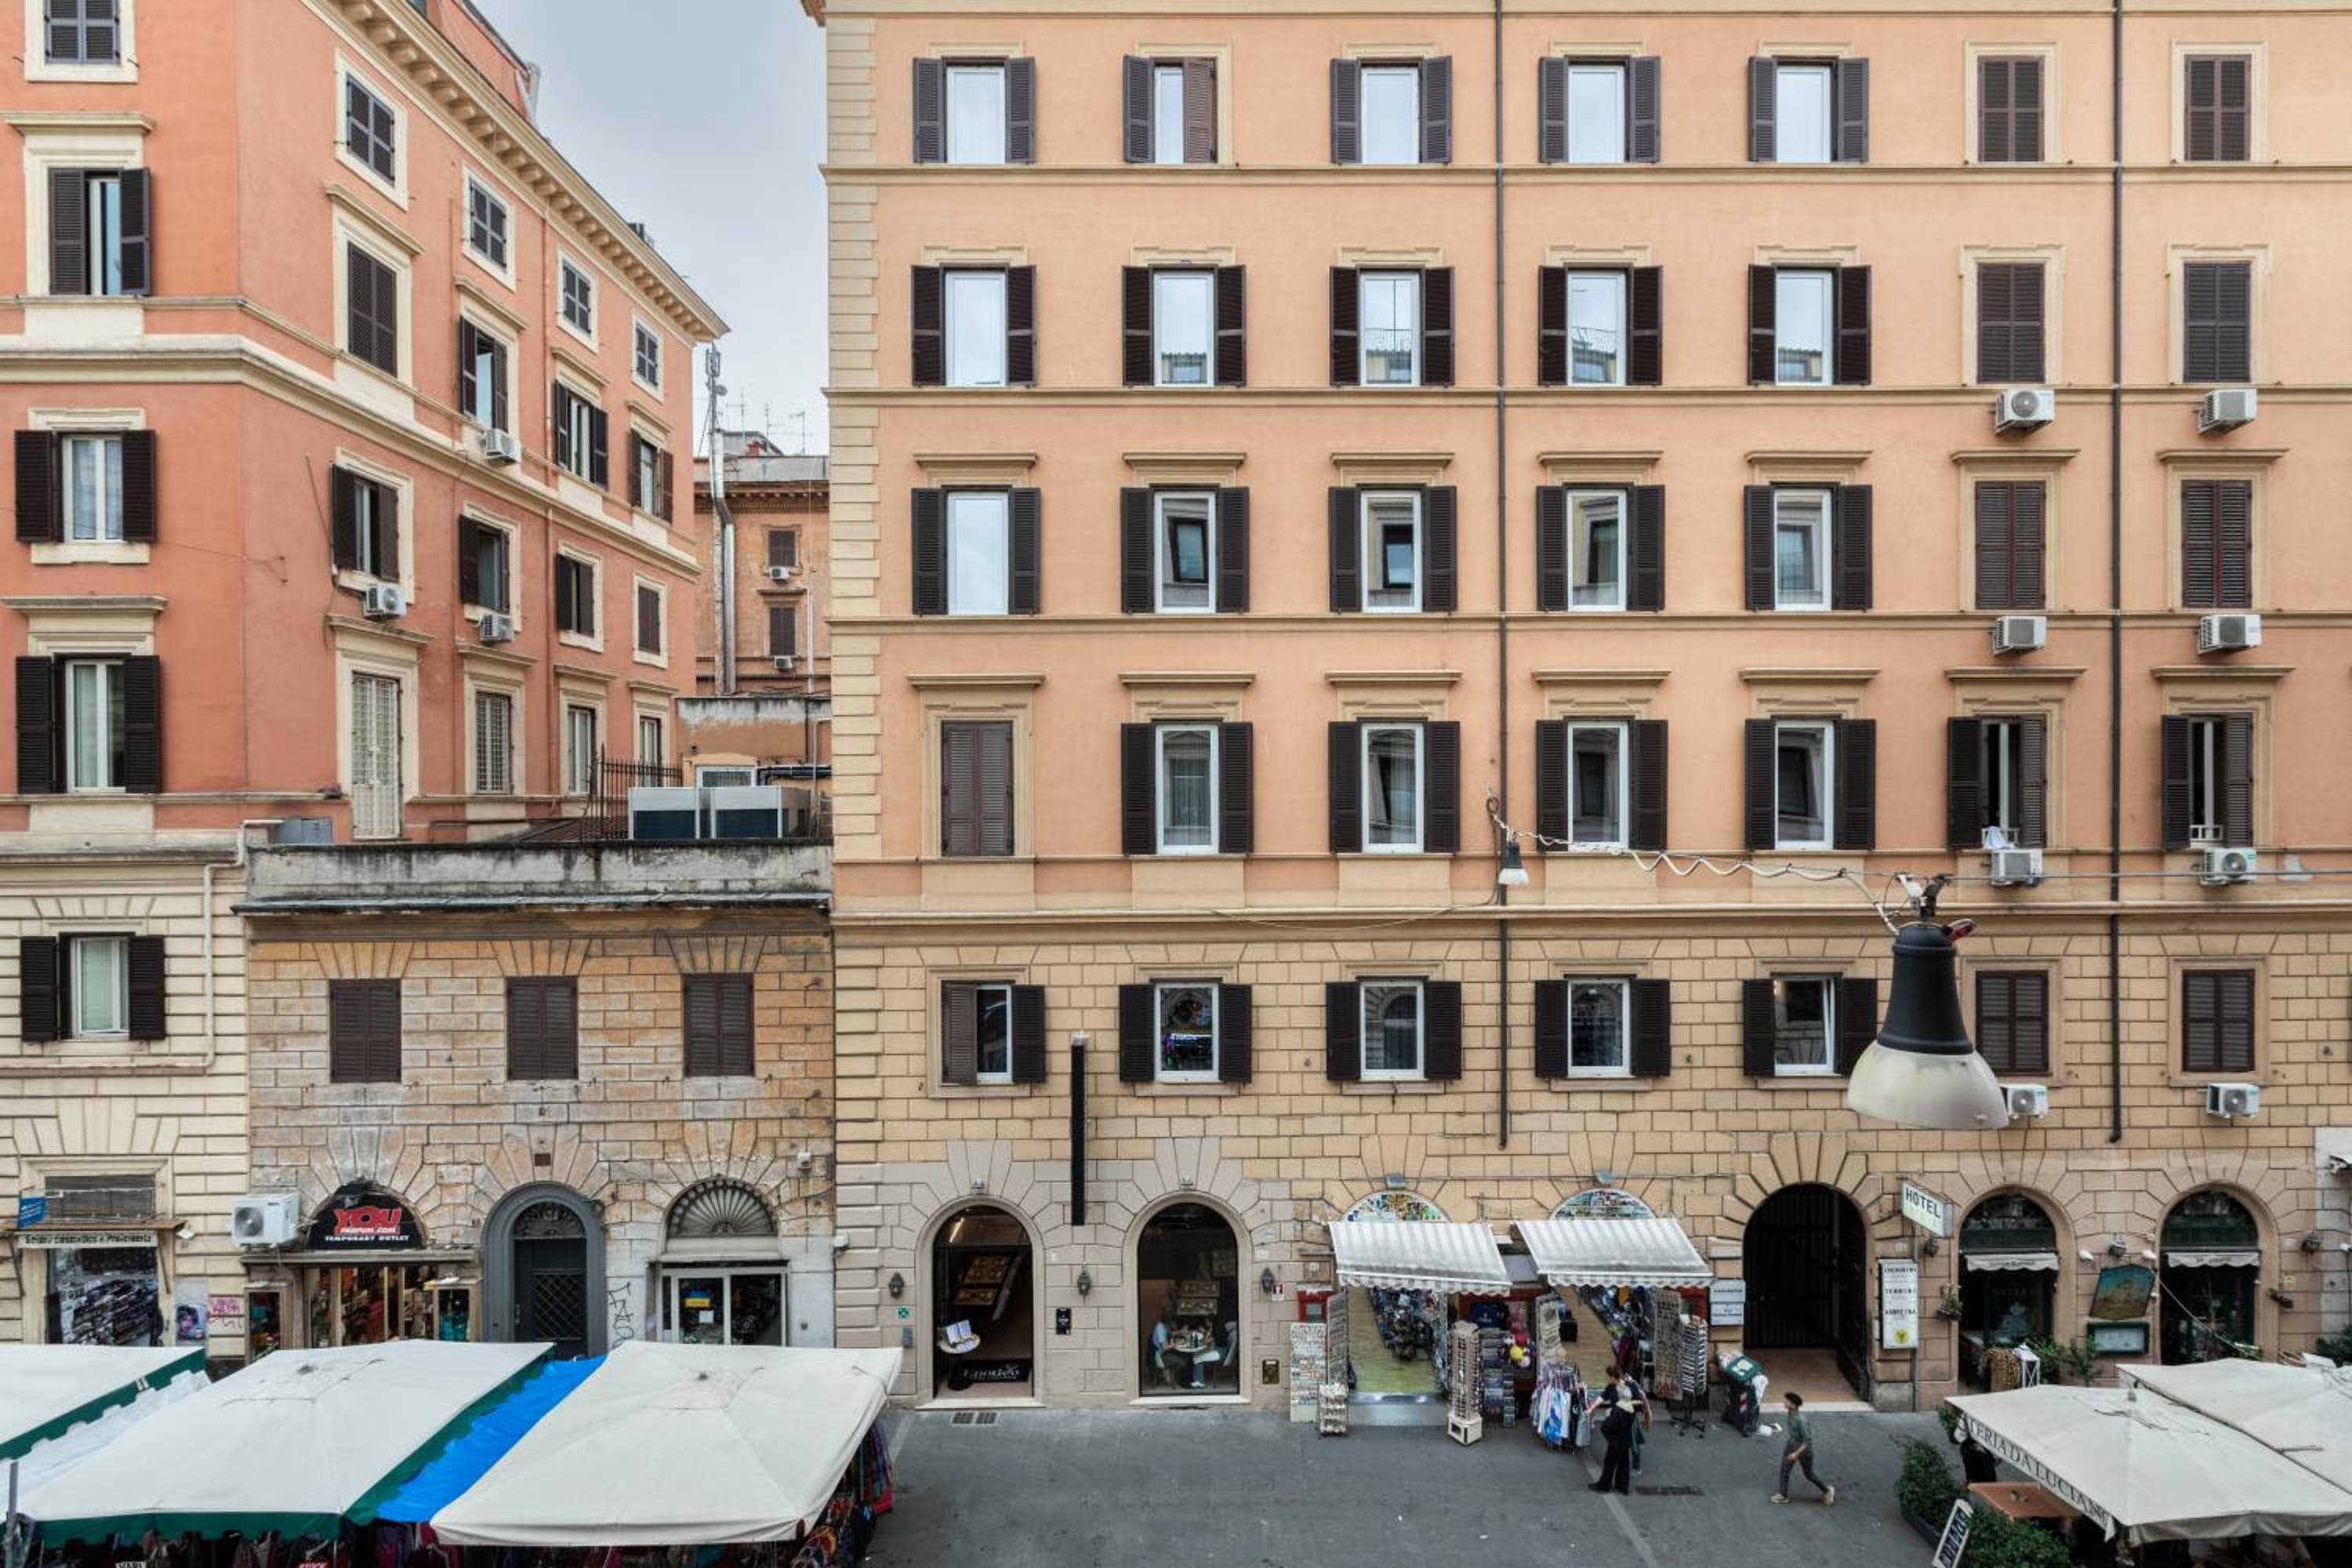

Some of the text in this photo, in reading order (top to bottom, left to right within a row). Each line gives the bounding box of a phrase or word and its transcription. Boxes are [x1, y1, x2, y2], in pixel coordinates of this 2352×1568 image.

[1906, 1188, 1941, 1218] HOTEL
[333, 1206, 402, 1232] YOU
[2009, 1444, 2033, 1472] DA
